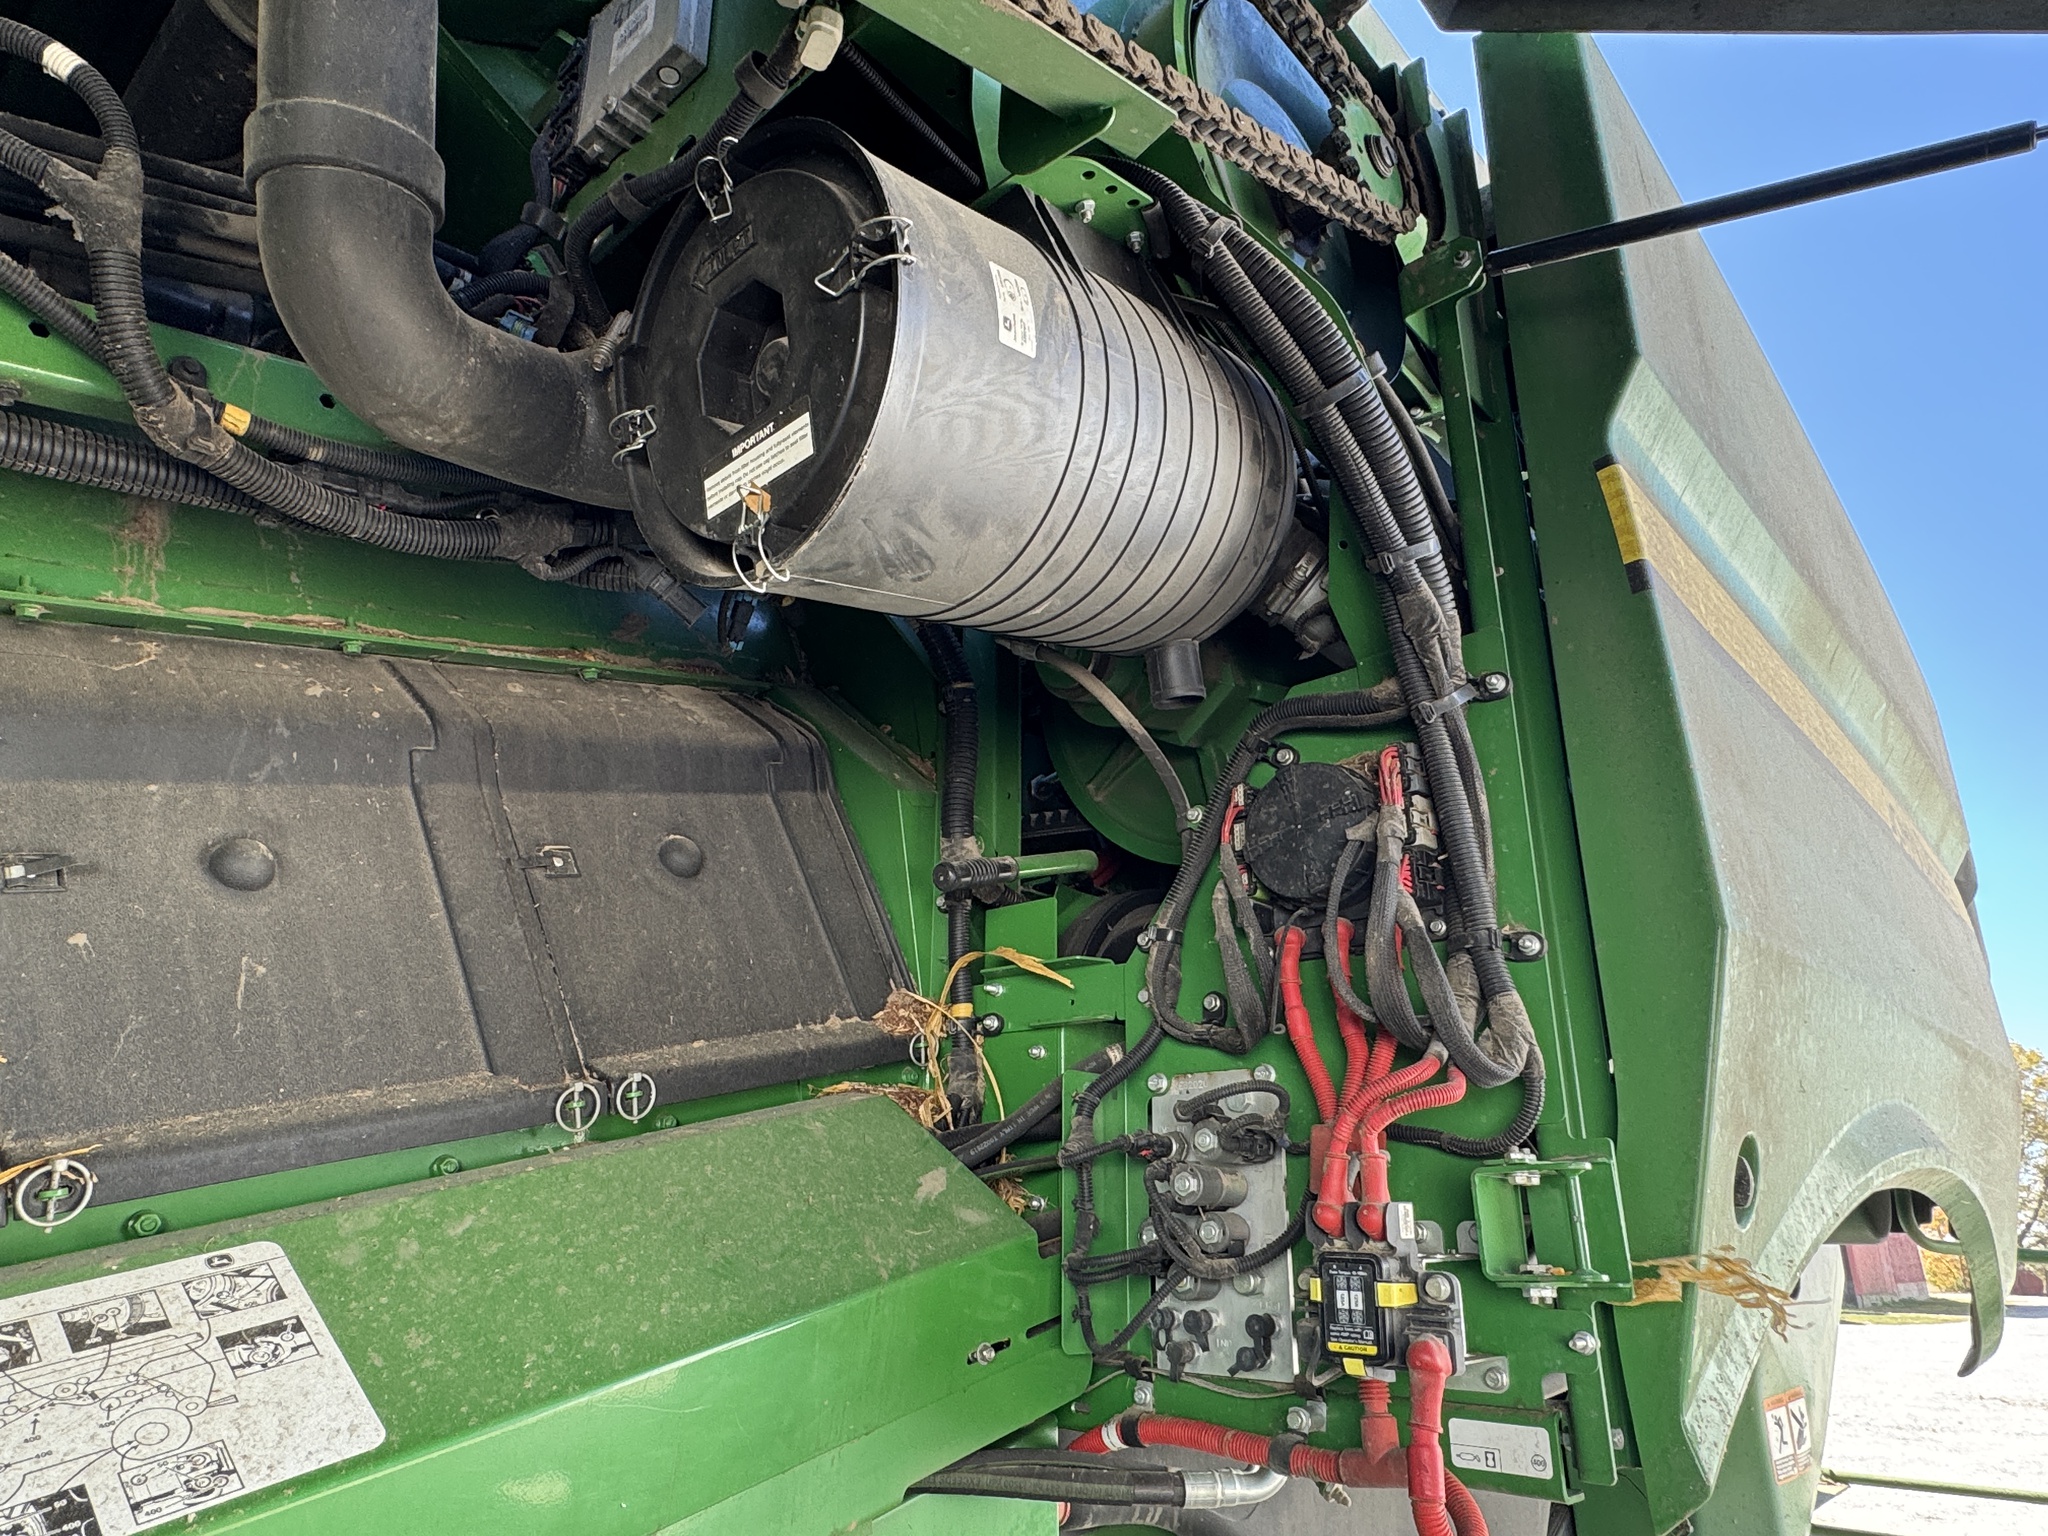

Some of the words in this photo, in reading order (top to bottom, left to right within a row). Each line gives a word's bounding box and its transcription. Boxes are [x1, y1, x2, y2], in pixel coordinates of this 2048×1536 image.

[731, 422, 775, 458] IMPORTANT
[1016, 1115, 1025, 1124] IN
[999, 1123, 1017, 1137] ITALY
[23, 1435, 41, 1443] 400
[34, 1450, 53, 1459] 400
[144, 1507, 162, 1516] 400
[62, 1520, 81, 1530] 400
